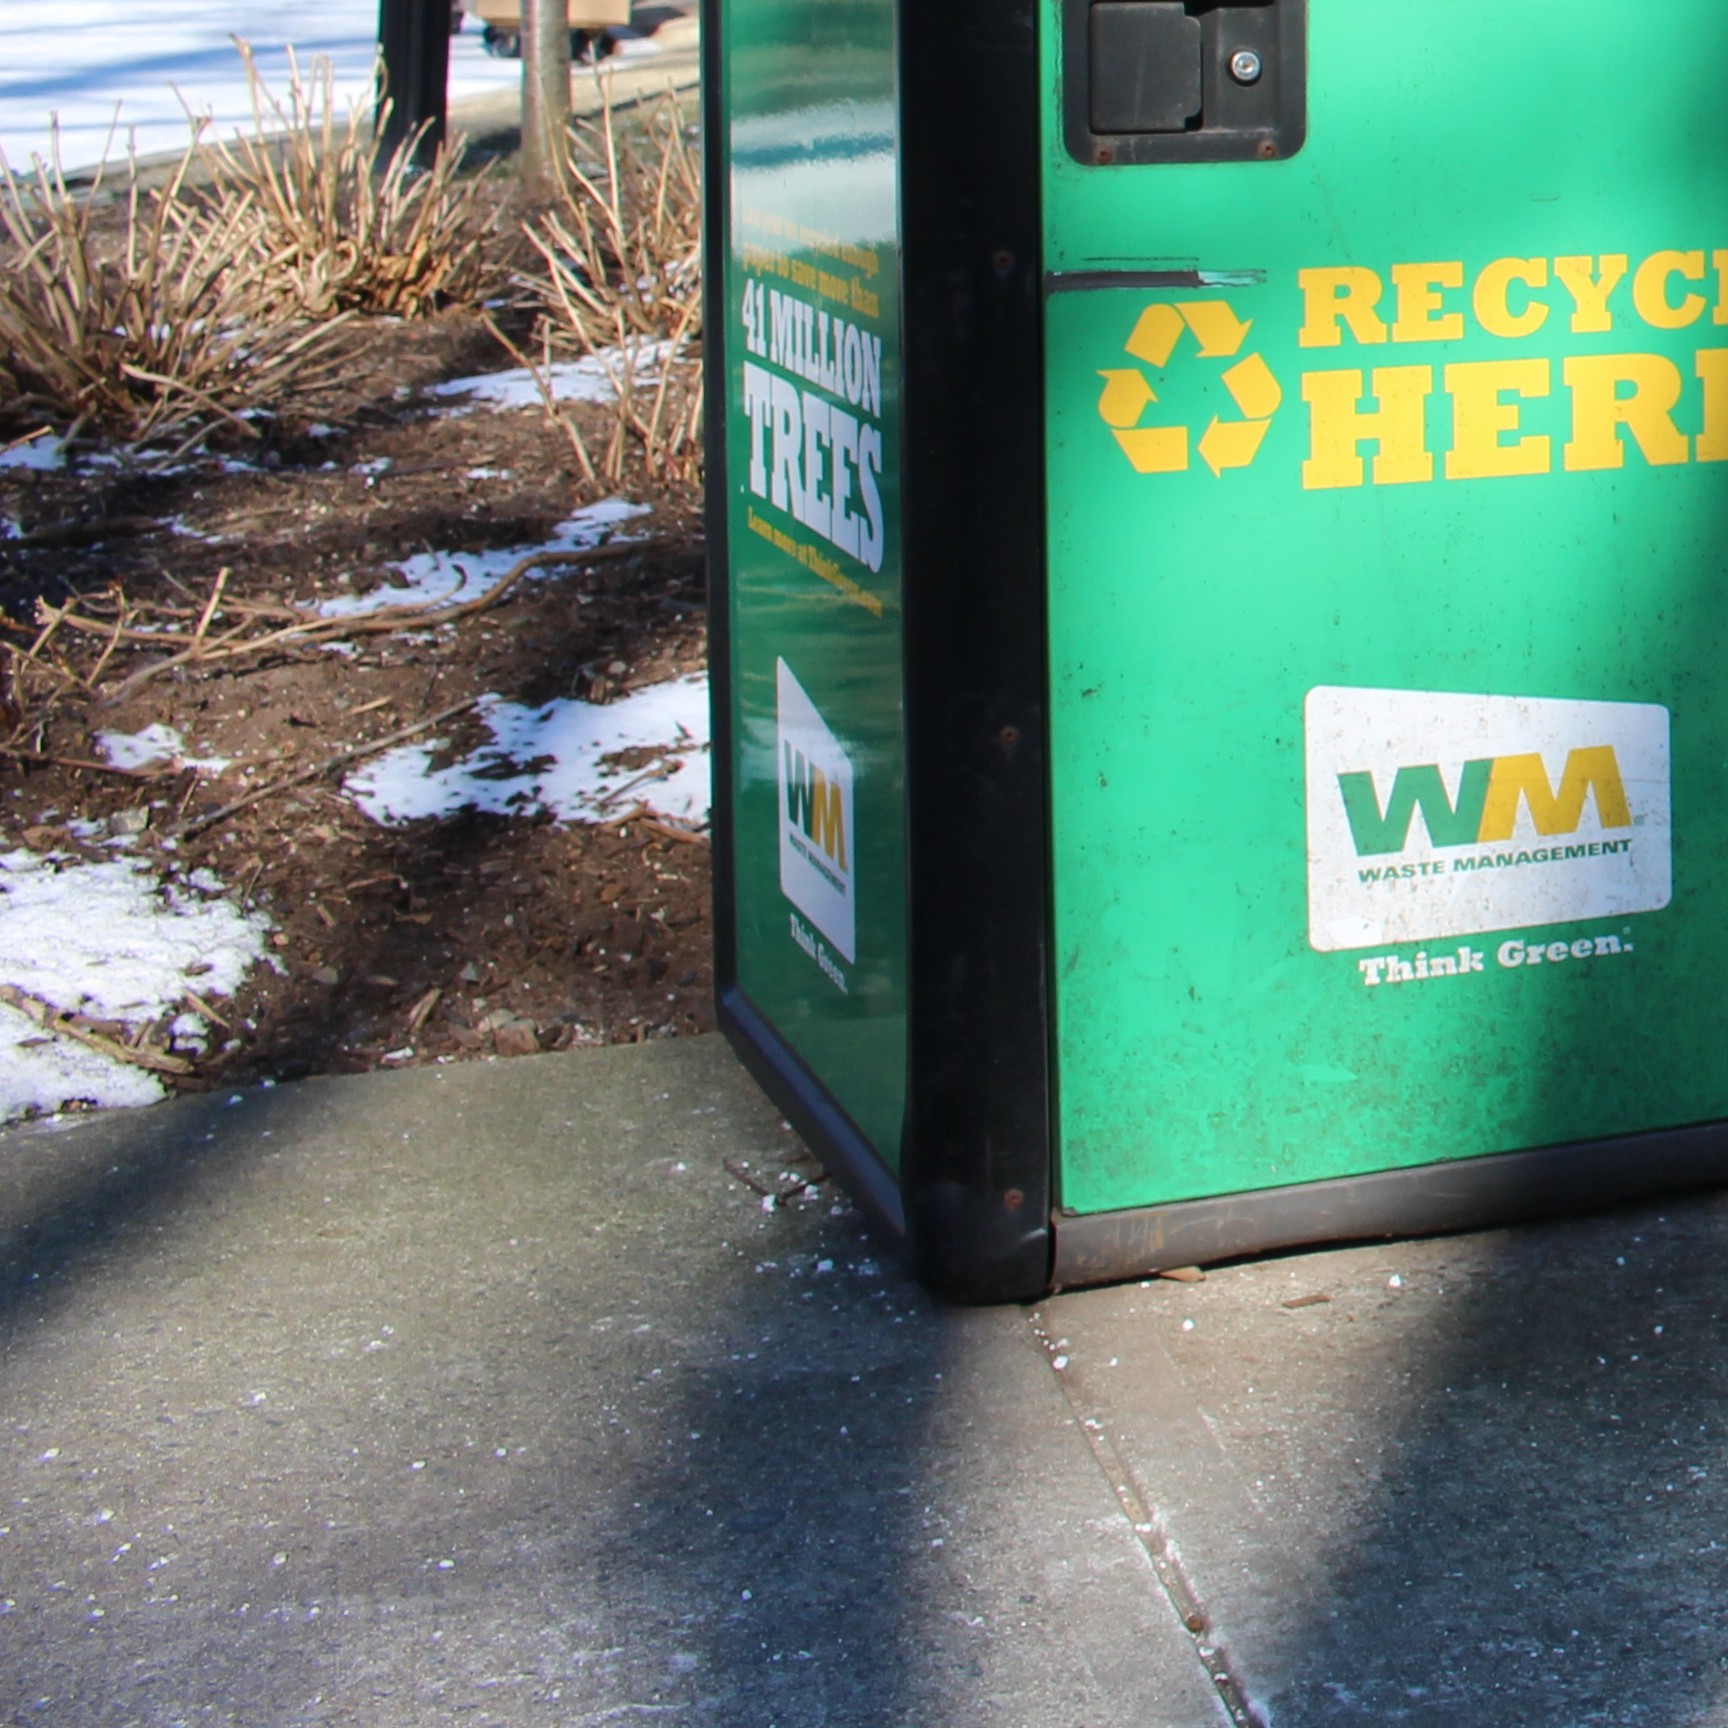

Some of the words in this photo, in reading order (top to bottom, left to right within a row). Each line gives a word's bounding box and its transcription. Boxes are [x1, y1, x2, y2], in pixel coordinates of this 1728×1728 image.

[742, 278, 766, 358] 41
[770, 288, 881, 419] MILLION
[743, 360, 884, 573] TREES
[783, 738, 848, 874] WM
[1337, 745, 1632, 858] WM
[1358, 860, 1446, 883] WASTE
[1453, 838, 1633, 873] MANAGEMENT
[1358, 947, 1484, 986] Think
[1497, 932, 1635, 969] Green.
